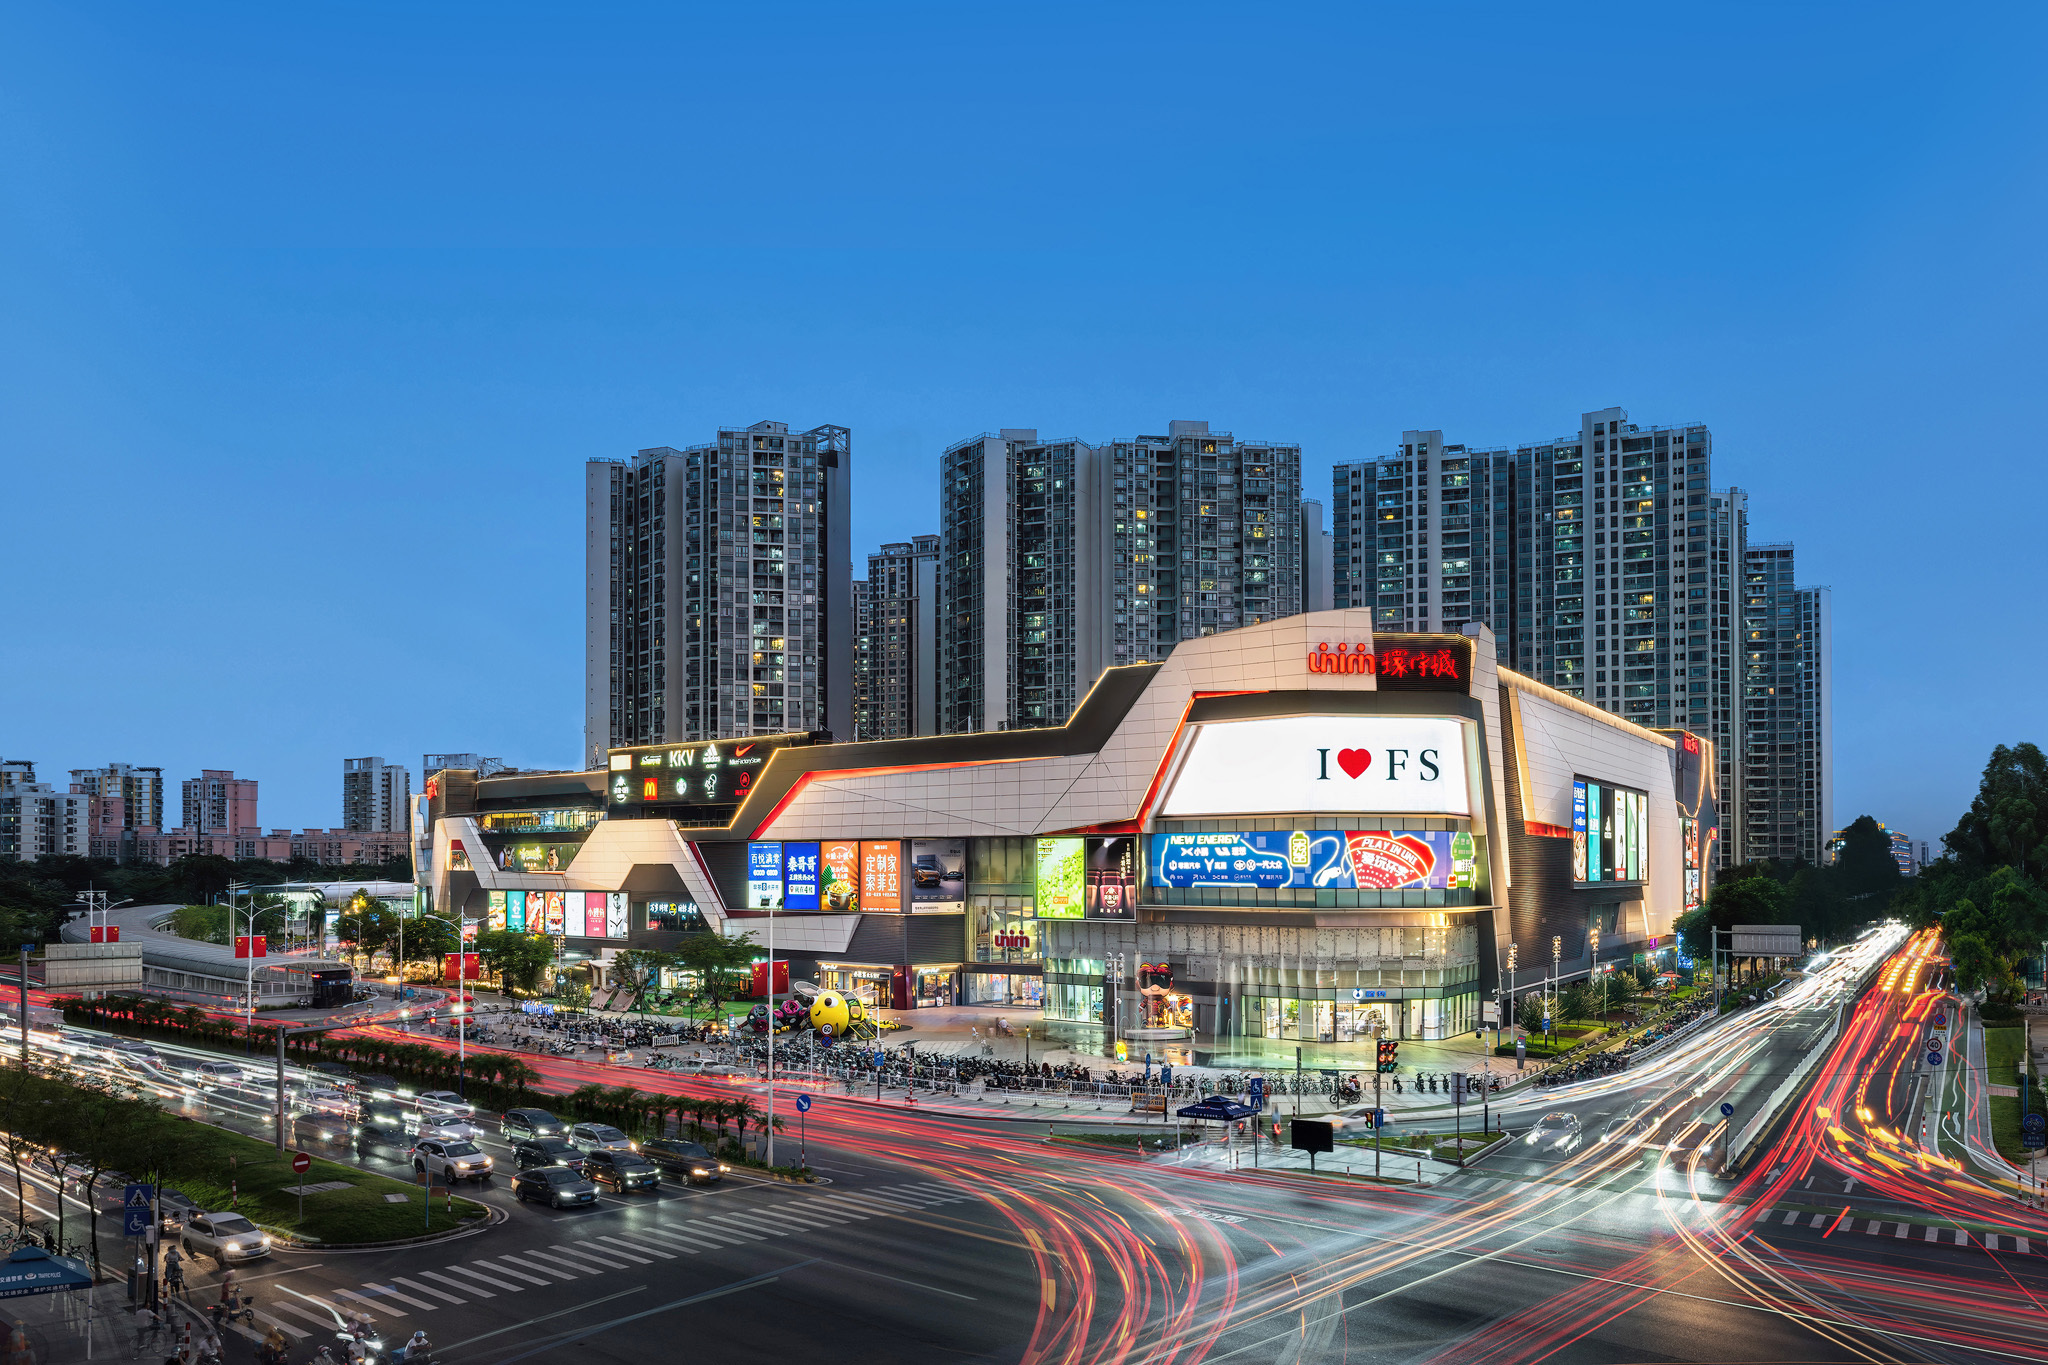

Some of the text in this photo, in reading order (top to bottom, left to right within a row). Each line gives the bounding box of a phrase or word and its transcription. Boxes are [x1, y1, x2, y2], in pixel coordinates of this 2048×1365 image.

[669, 749, 695, 768] KKV
[702, 755, 721, 763] adidas
[1317, 748, 1331, 780] I
[1170, 835, 1241, 845] NEW ENERGY
[1361, 838, 1418, 866] PLAY IN UNI
[865, 854, 897, 872] 定制家
[1256, 860, 1283, 870] 一汽大众
